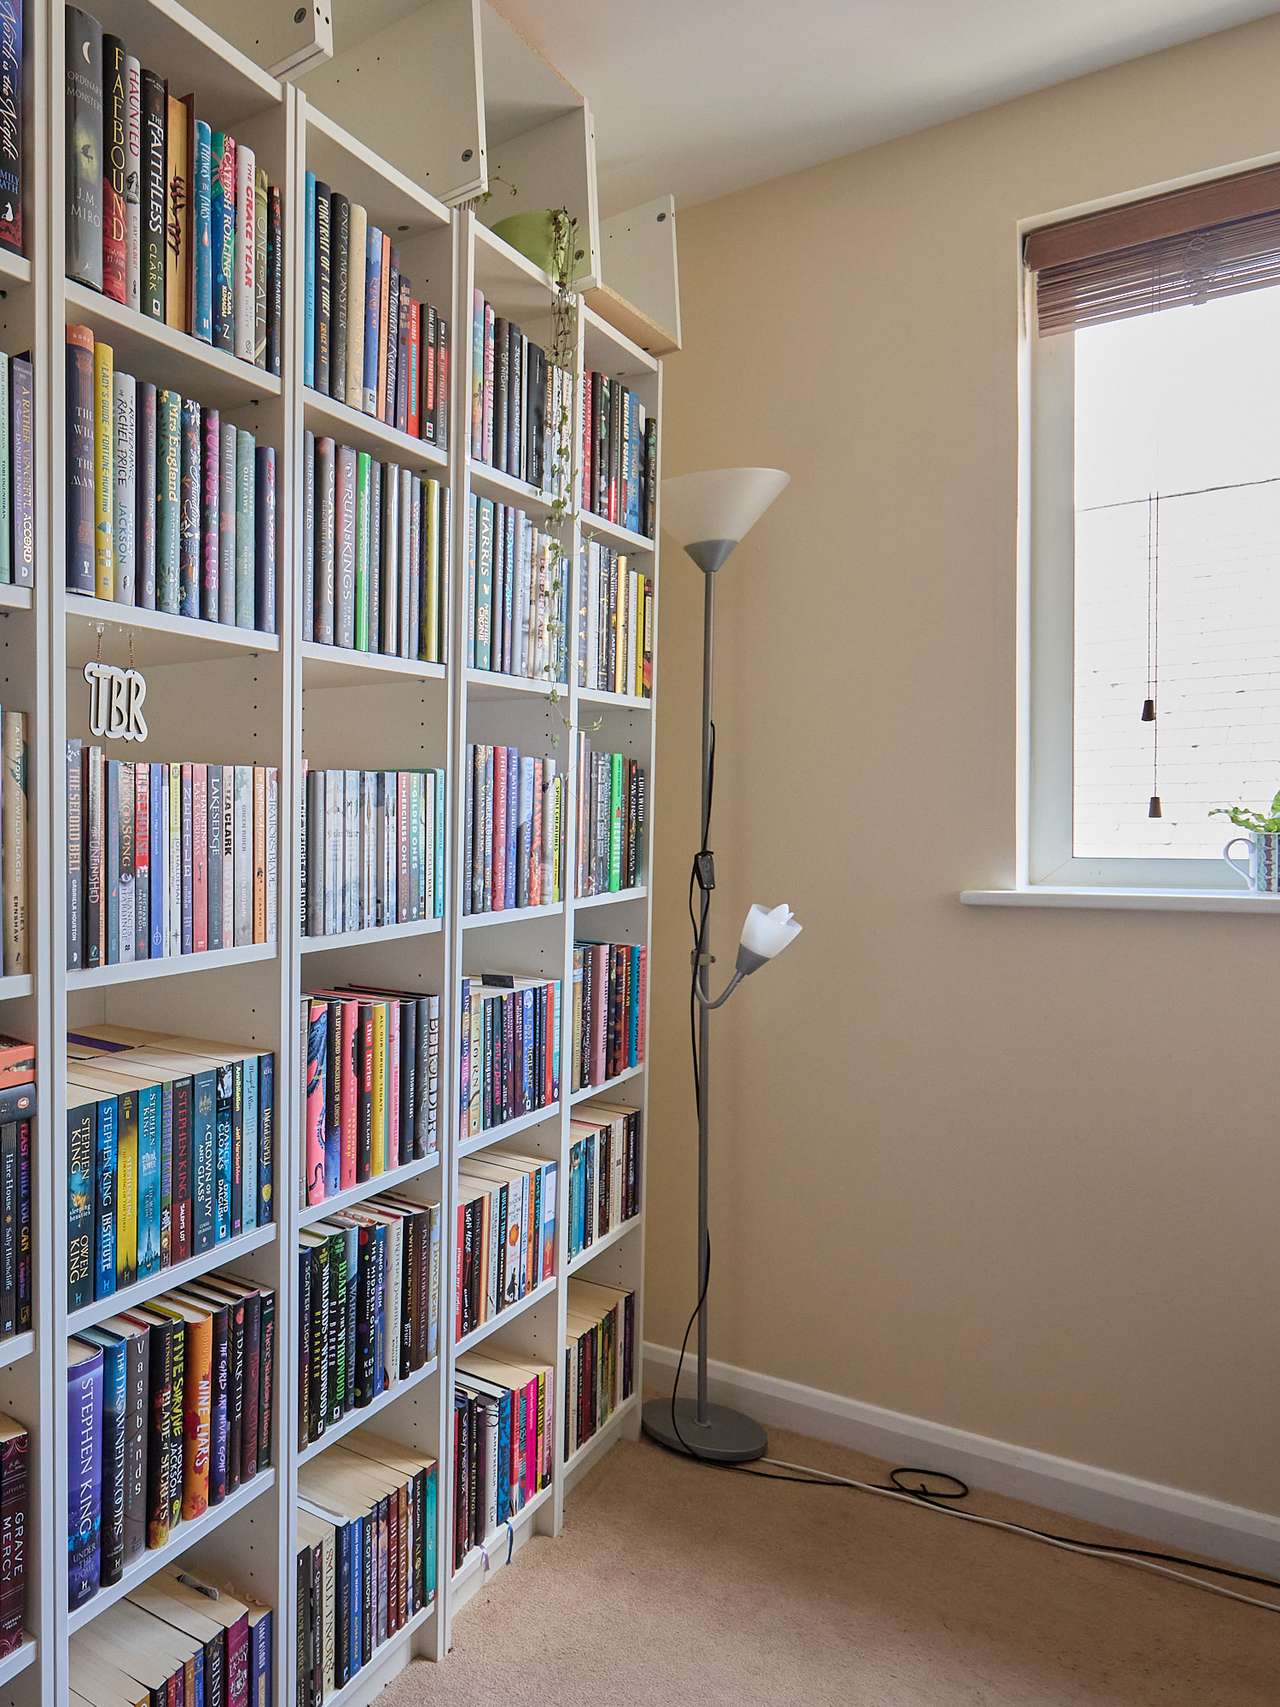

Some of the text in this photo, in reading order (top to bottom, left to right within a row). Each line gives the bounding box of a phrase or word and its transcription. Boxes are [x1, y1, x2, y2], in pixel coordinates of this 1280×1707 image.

[128, 68, 139, 157] HAUNTED
[222, 213, 233, 277] ROLLING
[244, 186, 254, 289] GRACE YEAR
[118, 502, 127, 565] JACKSON
[480, 506, 491, 577] HARRIS
[85, 663, 148, 741] TBR
[224, 813, 232, 856] CLARK
[71, 1128, 82, 1174] KING
[81, 1117, 91, 1181] STEPHEN
[102, 1106, 113, 1167] STEPHEN
[102, 1170, 113, 1208] KING
[70, 1238, 81, 1285] KING
[79, 1234, 89, 1278] OWEN
[173, 1329, 184, 1378] FIVE
[195, 1380, 210, 1467] NINE LIARS
[79, 1377, 95, 1537] STEPHEN KING
[1, 1516, 12, 1584] MERCY
[13, 1512, 25, 1579] GRAVE
